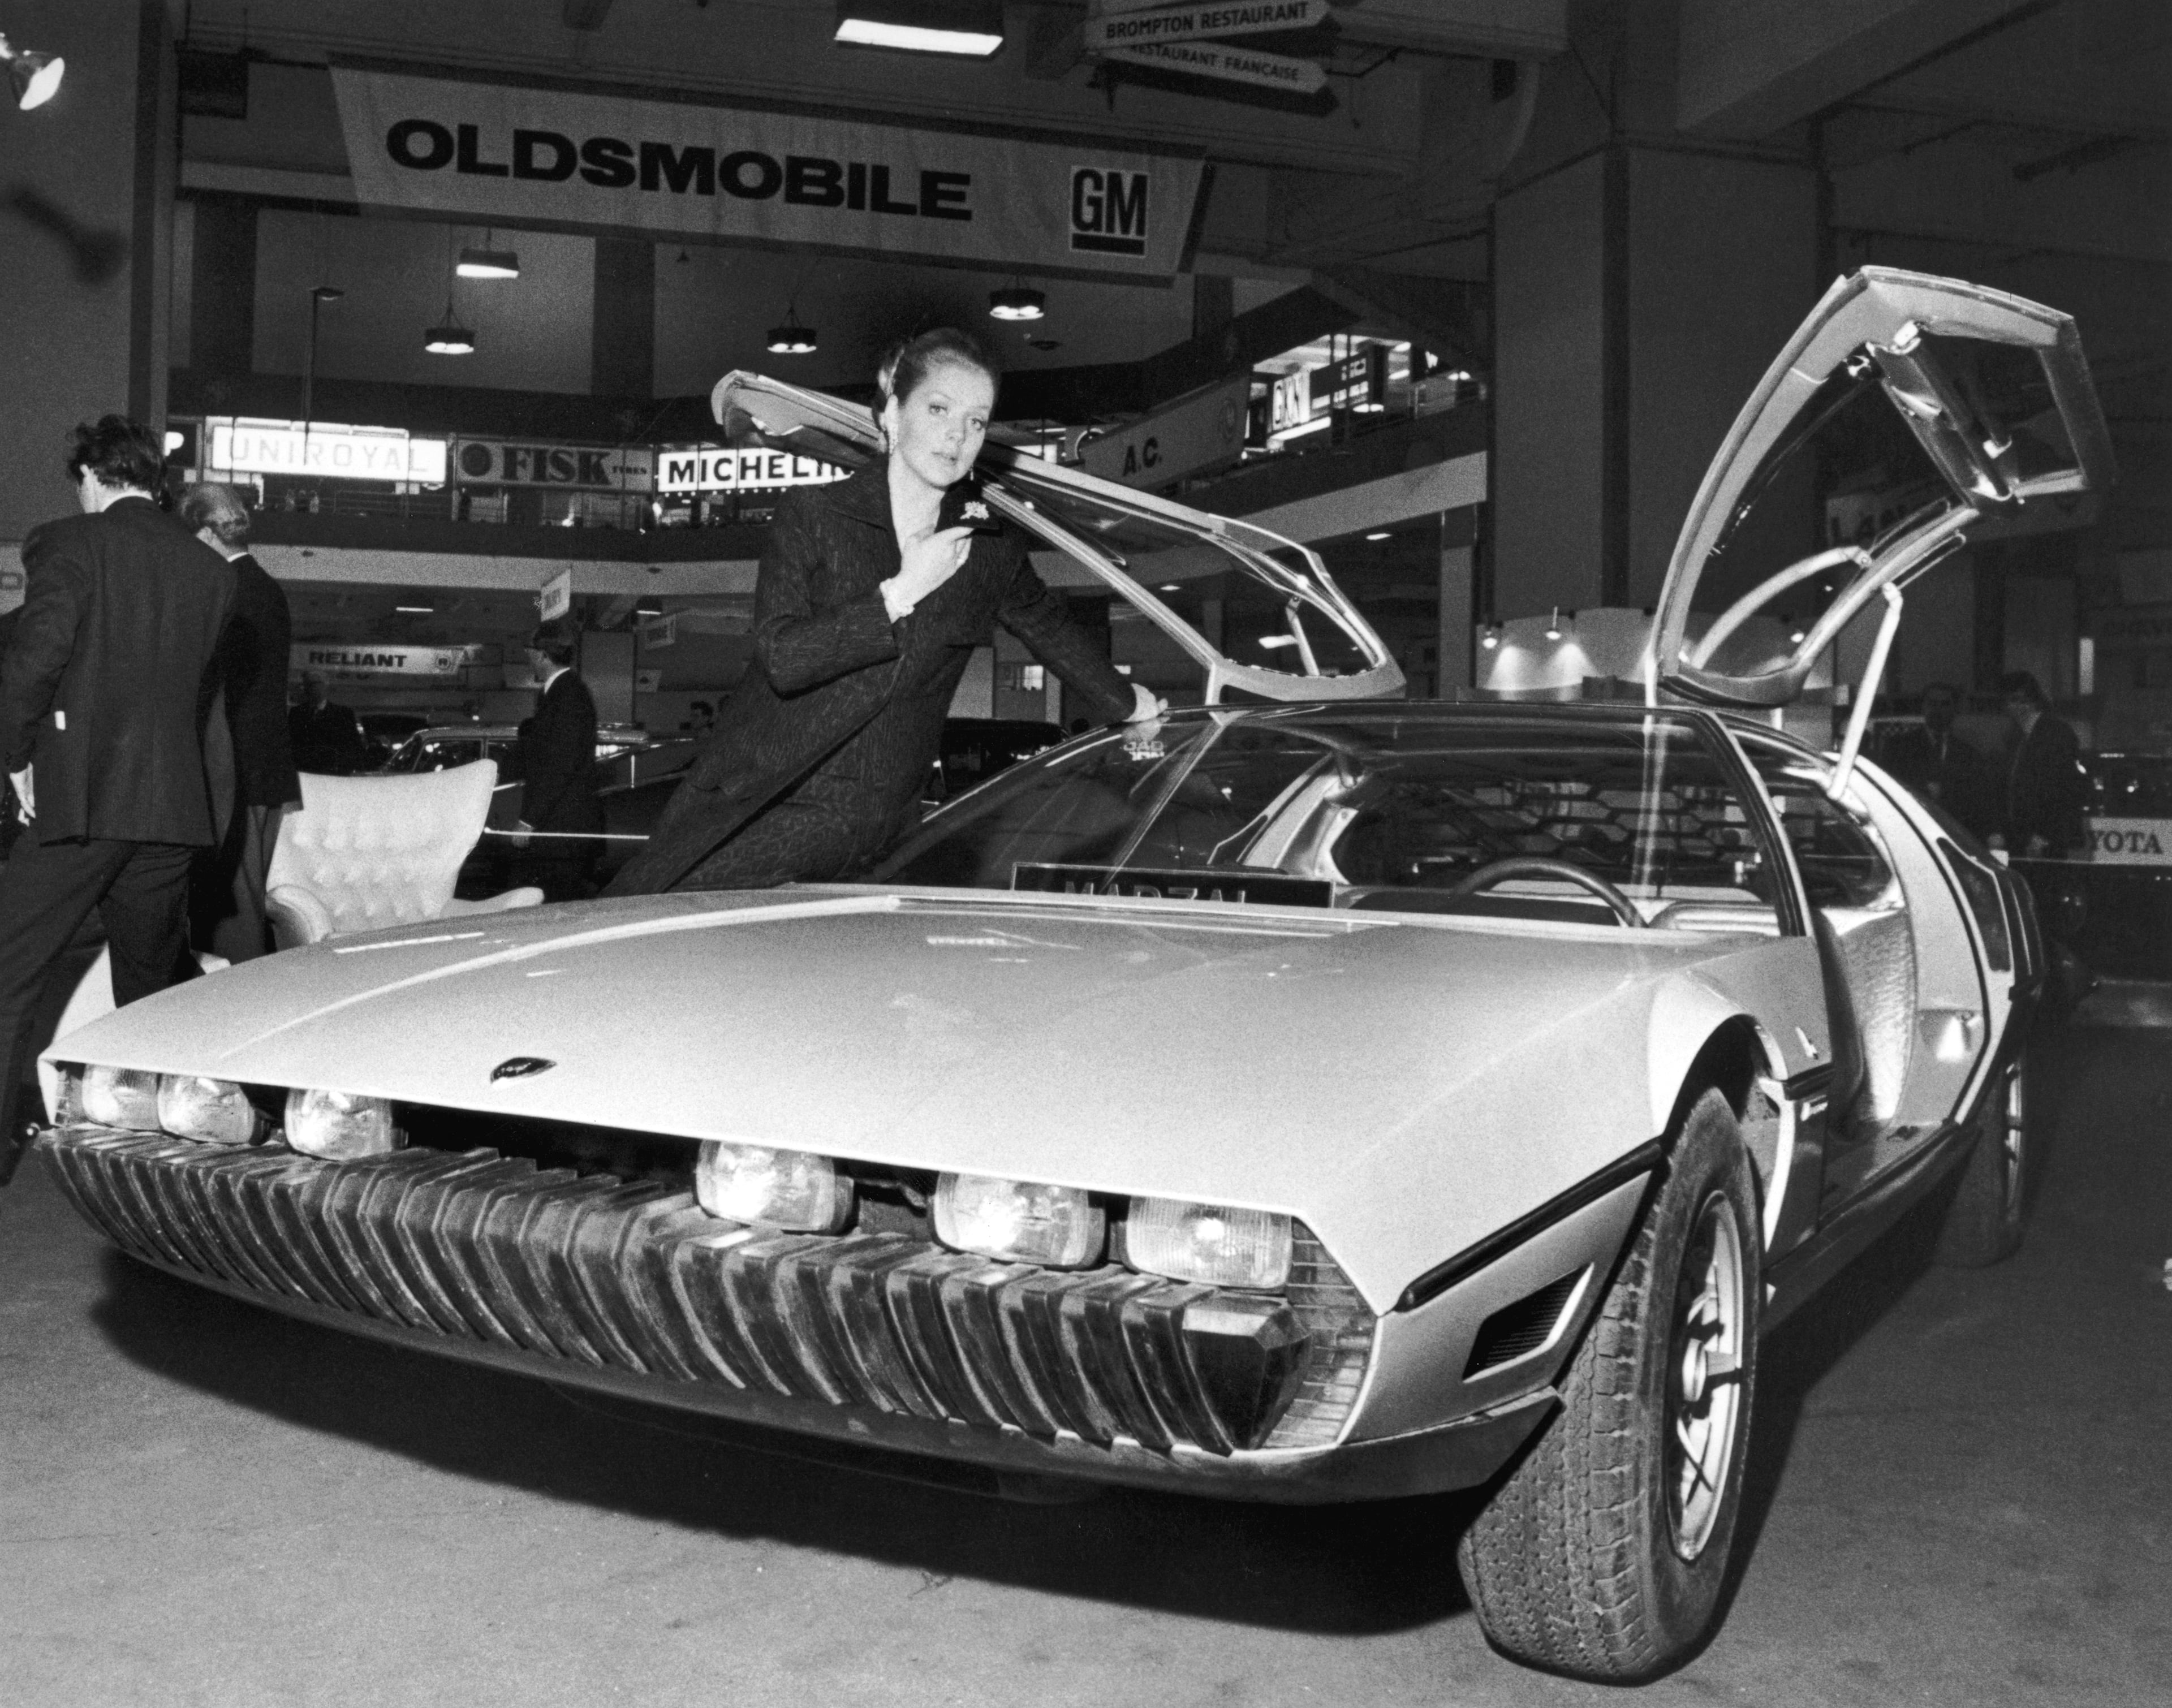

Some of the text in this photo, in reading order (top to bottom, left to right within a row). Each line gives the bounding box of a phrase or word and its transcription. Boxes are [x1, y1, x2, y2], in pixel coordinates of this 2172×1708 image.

[1105, 1, 1309, 39] BROMPTON RESTAURANT
[385, 118, 972, 222] OLDSMOBILE
[1072, 167, 1148, 238] GM
[229, 436, 429, 473] UNIROYAL
[501, 446, 612, 485] FISK
[308, 651, 408, 668] RELIANT
